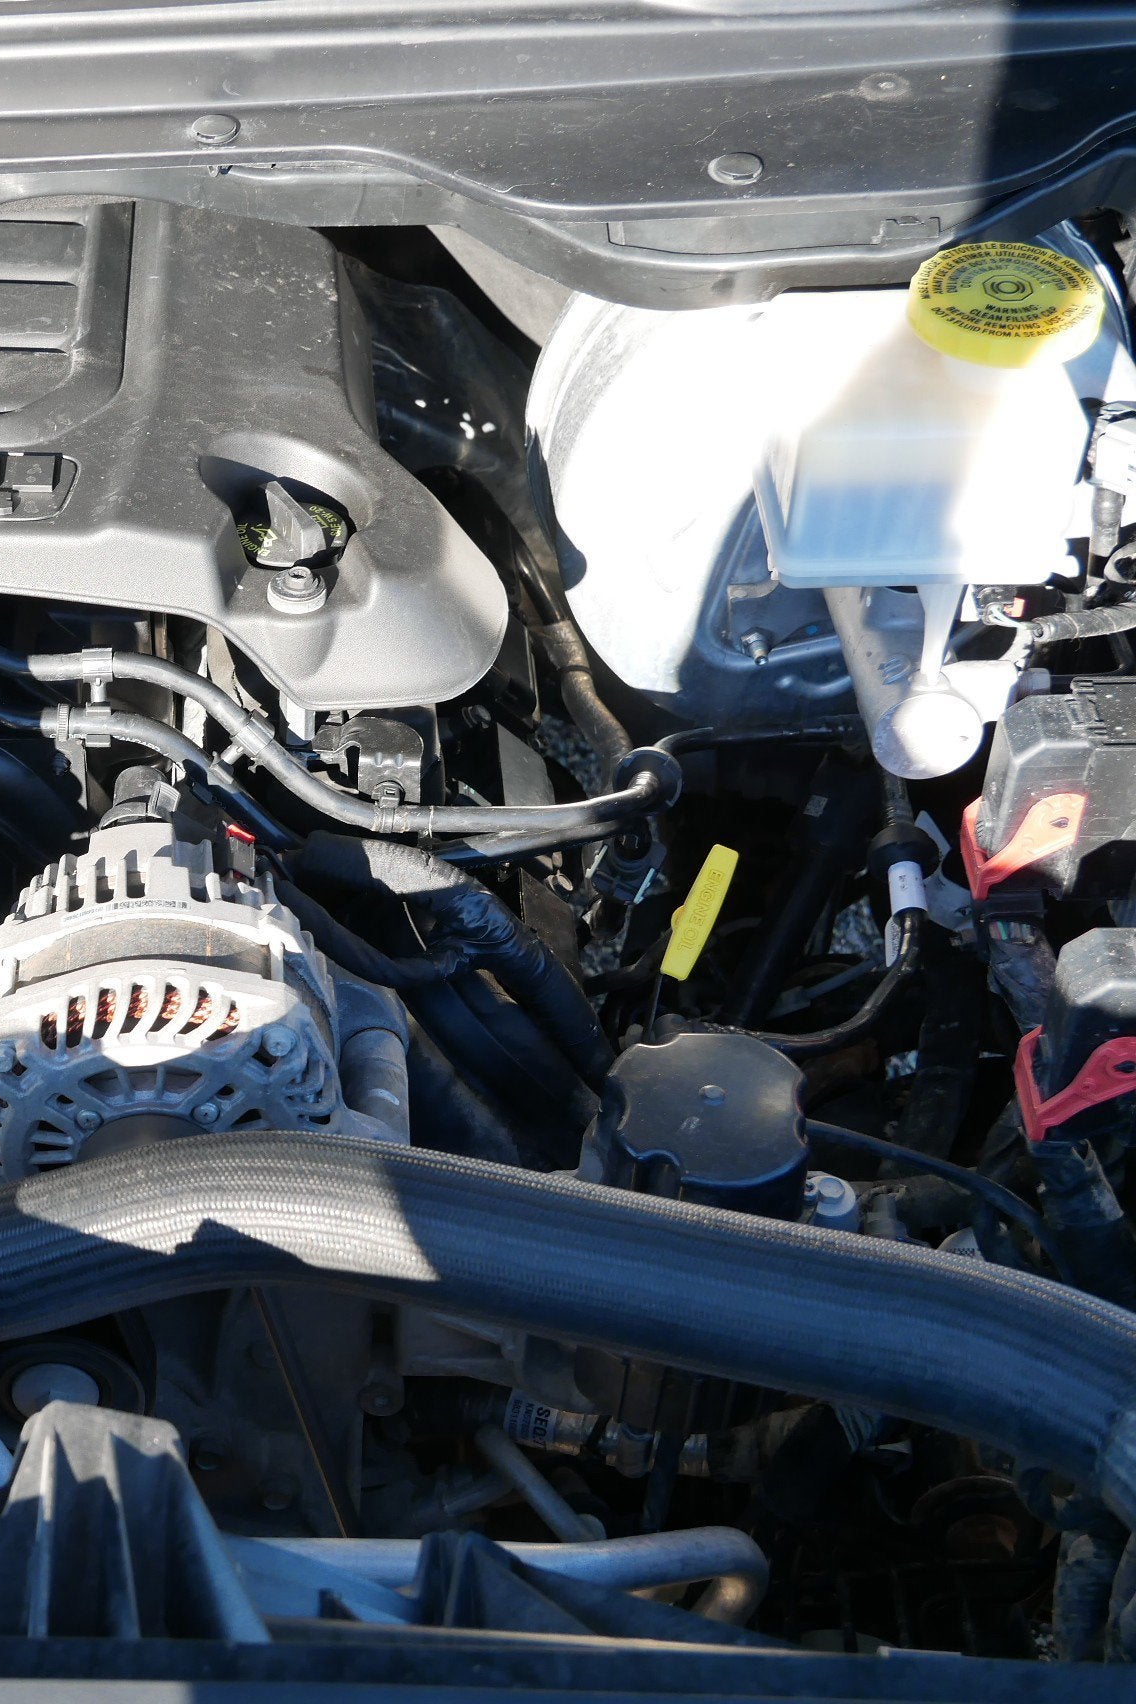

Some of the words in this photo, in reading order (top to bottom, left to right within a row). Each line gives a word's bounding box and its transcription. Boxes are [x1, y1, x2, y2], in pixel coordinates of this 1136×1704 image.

[995, 250, 1039, 262] UTILISER
[999, 243, 1047, 256] BOUCHON
[1049, 253, 1063, 261] DE
[930, 307, 952, 318] DOT
[952, 320, 981, 333] FLUID
[982, 328, 1012, 338] FROM
[945, 305, 983, 325] BEFORE
[1044, 314, 1064, 326] USE
[969, 308, 1003, 321] CLEAN
[1005, 313, 1041, 323] FILLER
[1040, 305, 1058, 318] CAP
[309, 505, 337, 523] 5W-20
[689, 868, 724, 927] ENGINE
[676, 926, 699, 951] OIL
